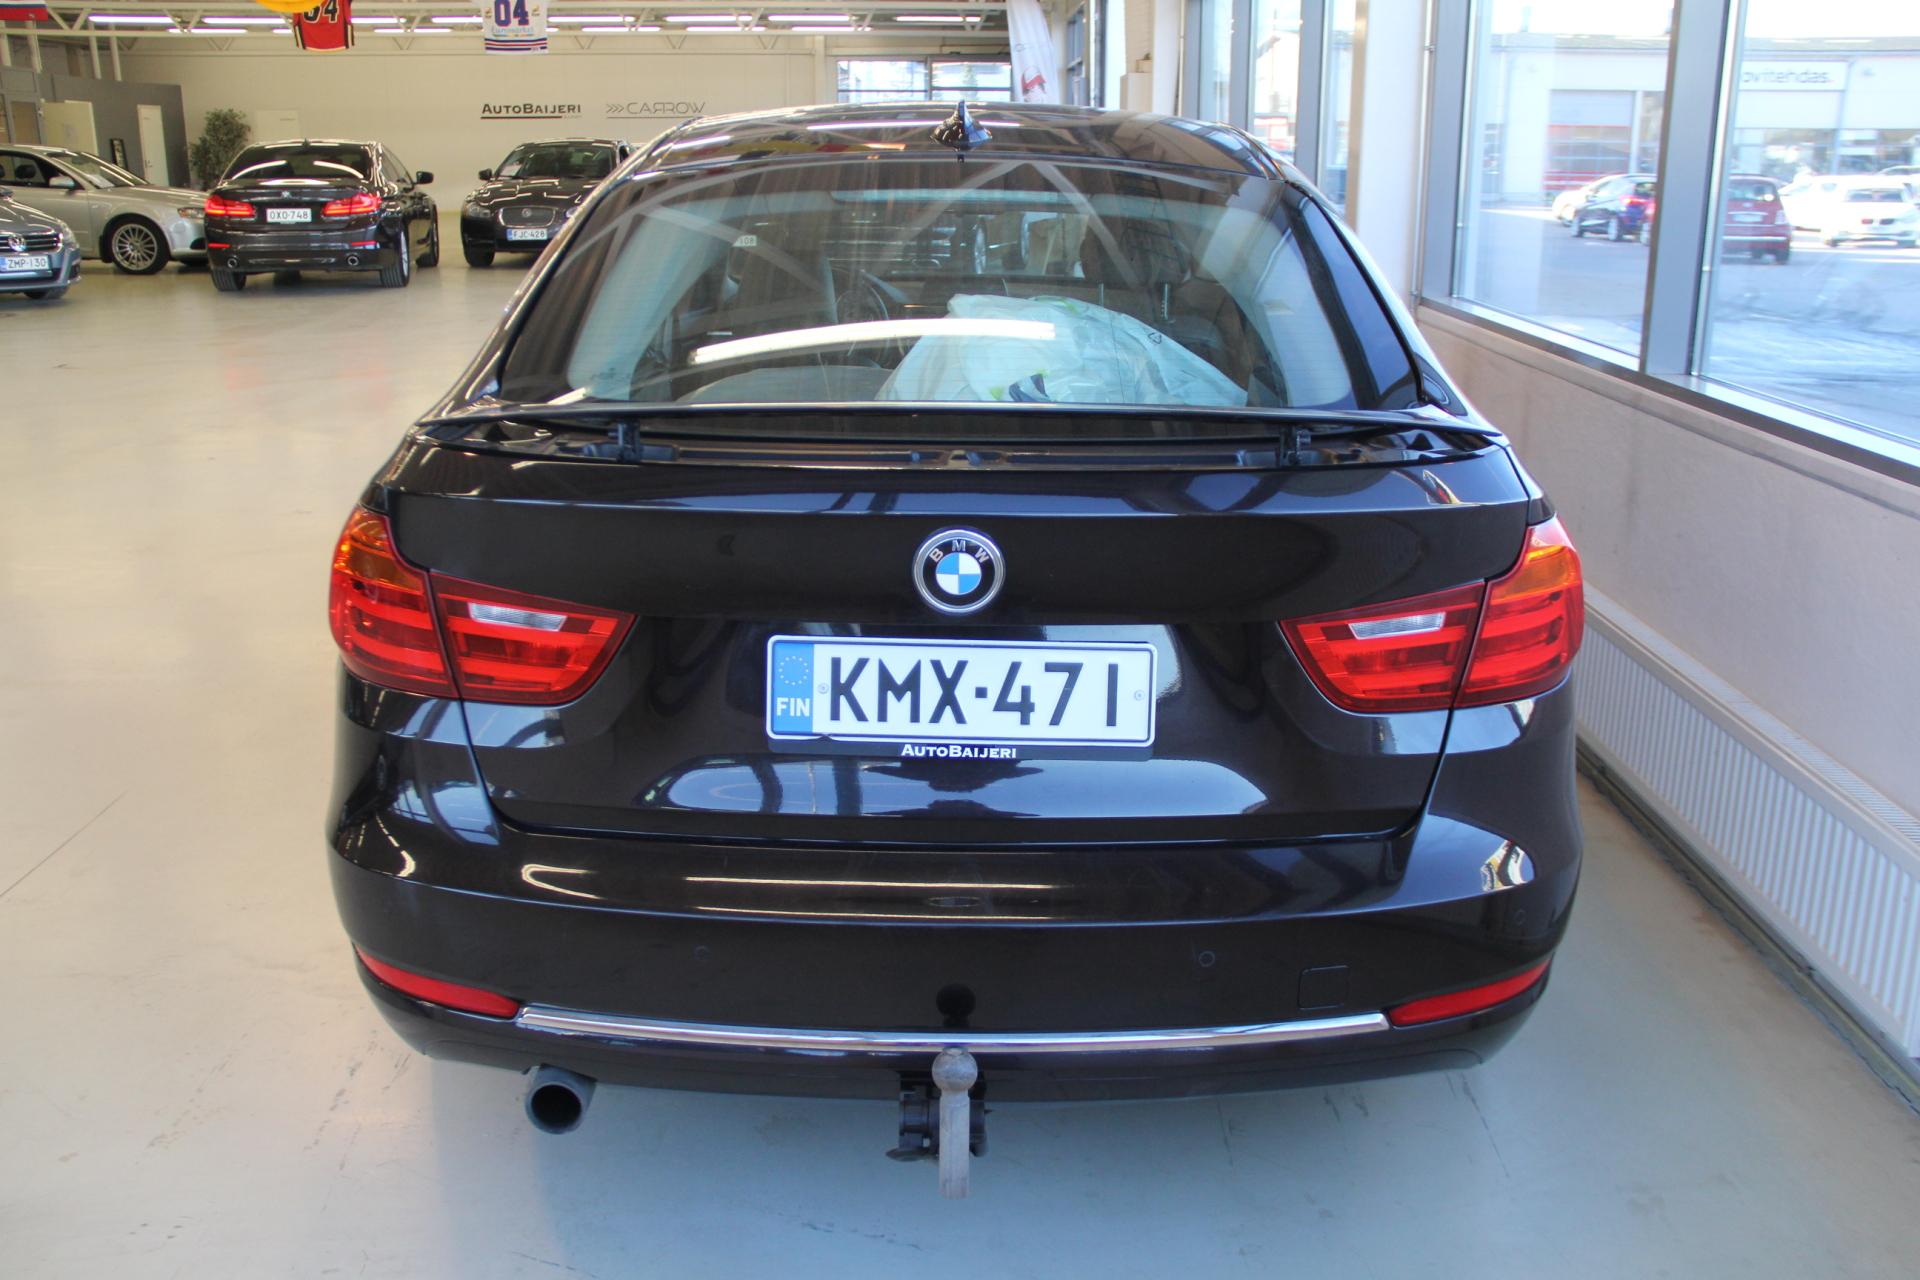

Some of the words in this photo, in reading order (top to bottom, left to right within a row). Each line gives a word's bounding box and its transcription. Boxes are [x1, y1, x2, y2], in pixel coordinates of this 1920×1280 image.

[494, 0, 529, 27] 04
[929, 539, 990, 563] BMW
[829, 656, 1119, 727] KMX-471
[776, 697, 811, 718] FIN
